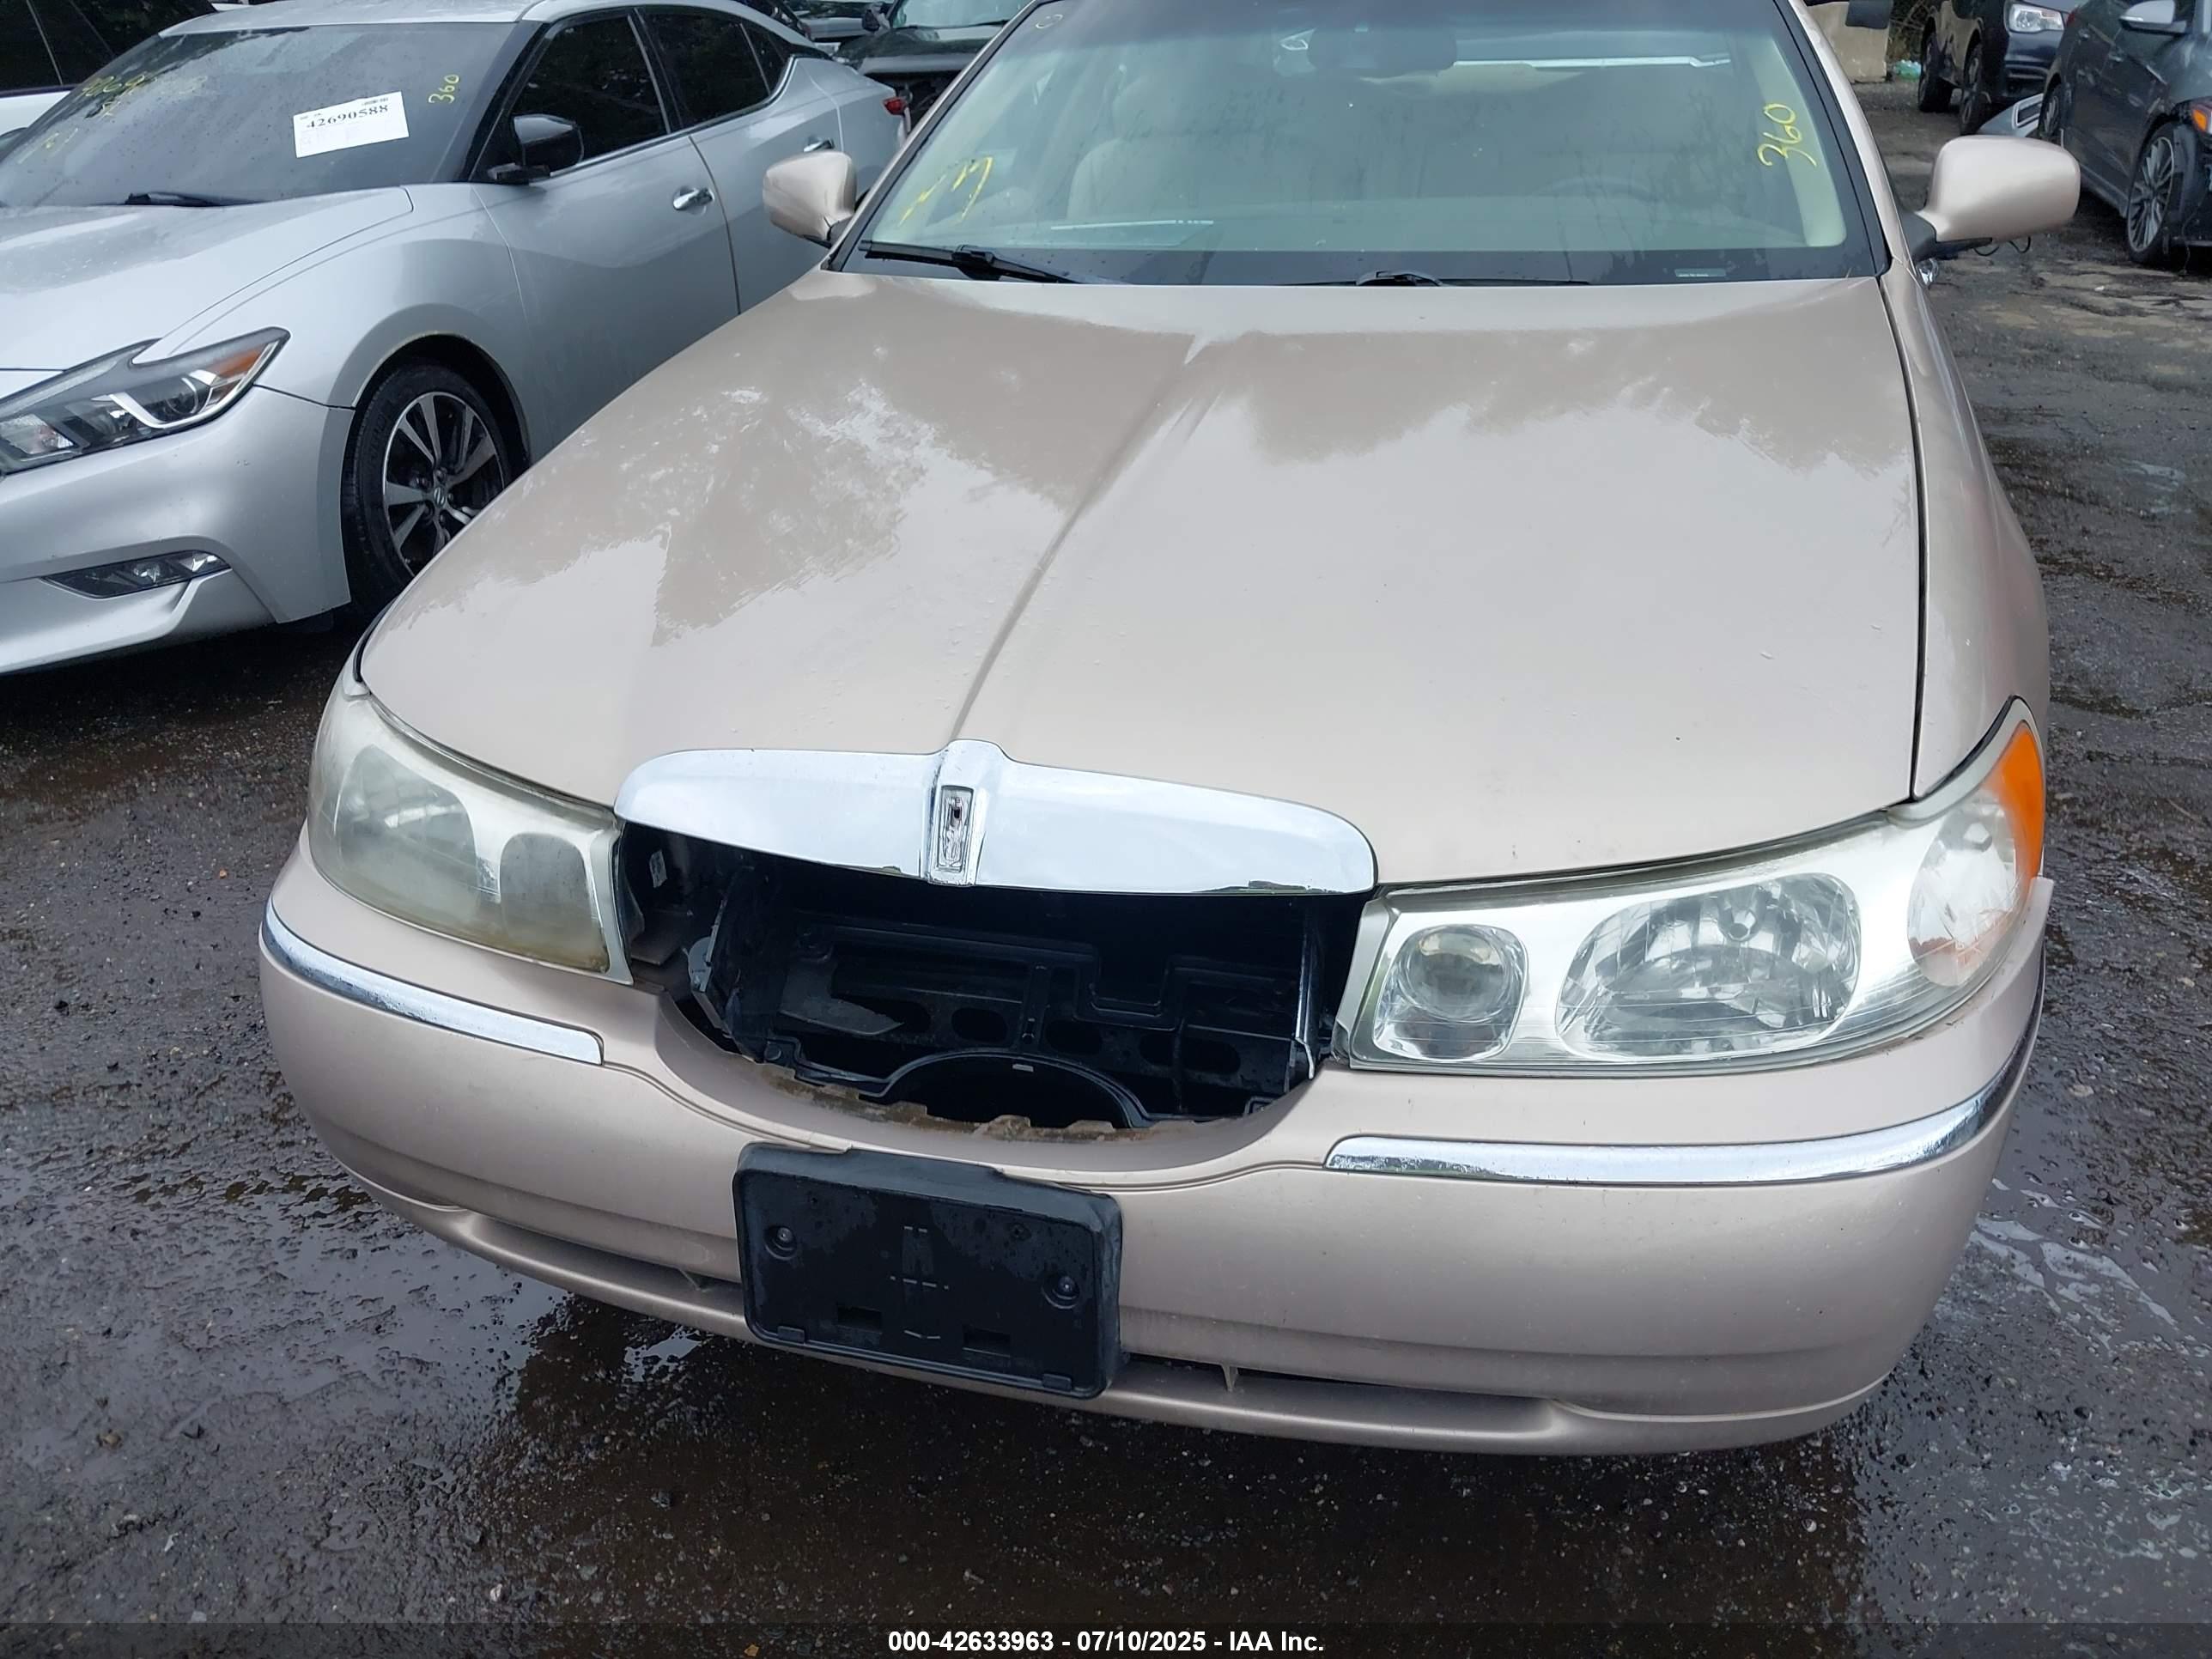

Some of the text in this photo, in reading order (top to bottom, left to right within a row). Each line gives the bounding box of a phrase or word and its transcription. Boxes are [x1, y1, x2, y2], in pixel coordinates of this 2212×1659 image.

[428, 74, 460, 104] 360
[307, 104, 389, 128] 42690588
[1757, 103, 1817, 167] 360
